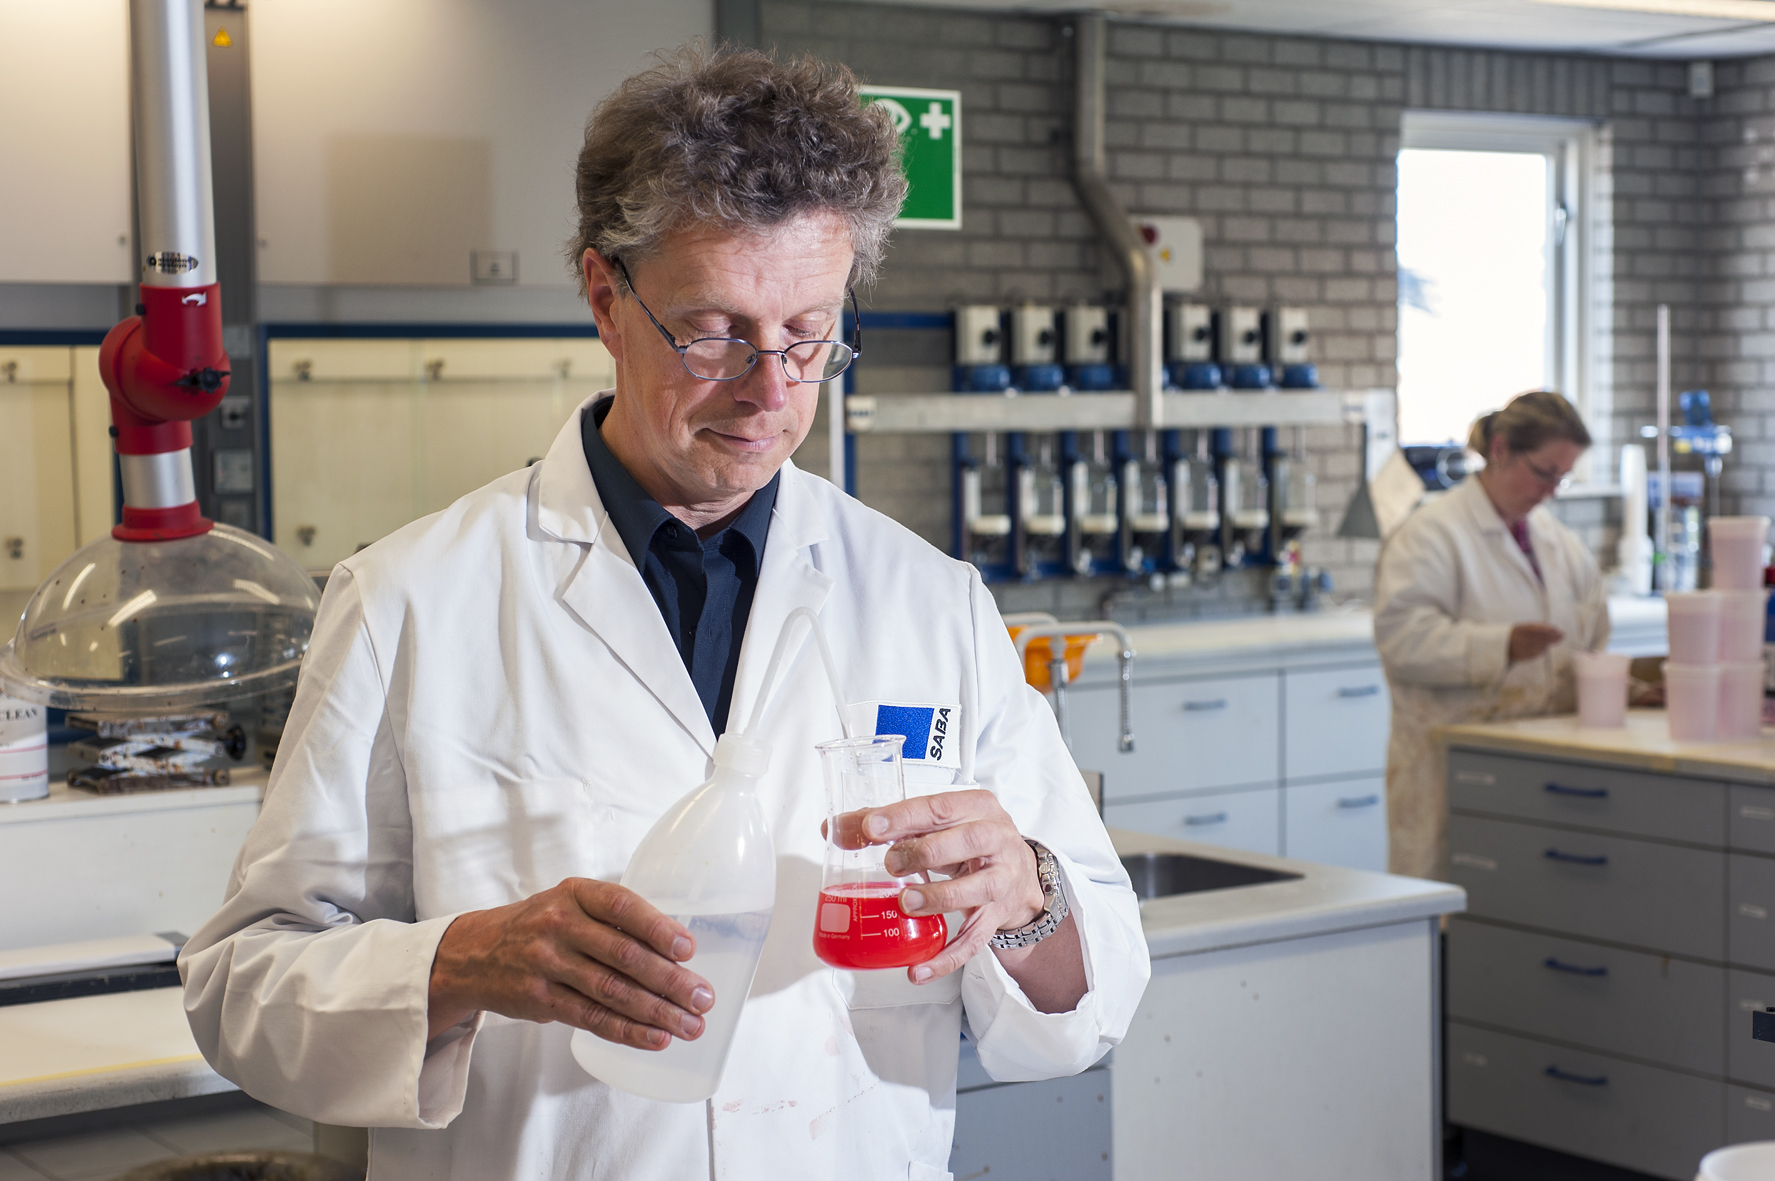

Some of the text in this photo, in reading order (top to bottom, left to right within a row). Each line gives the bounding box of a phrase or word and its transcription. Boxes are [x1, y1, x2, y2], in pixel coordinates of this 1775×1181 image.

[930, 708, 951, 761] SABA
[824, 894, 836, 903] 250
[881, 910, 898, 919] 150
[883, 928, 900, 937] 100
